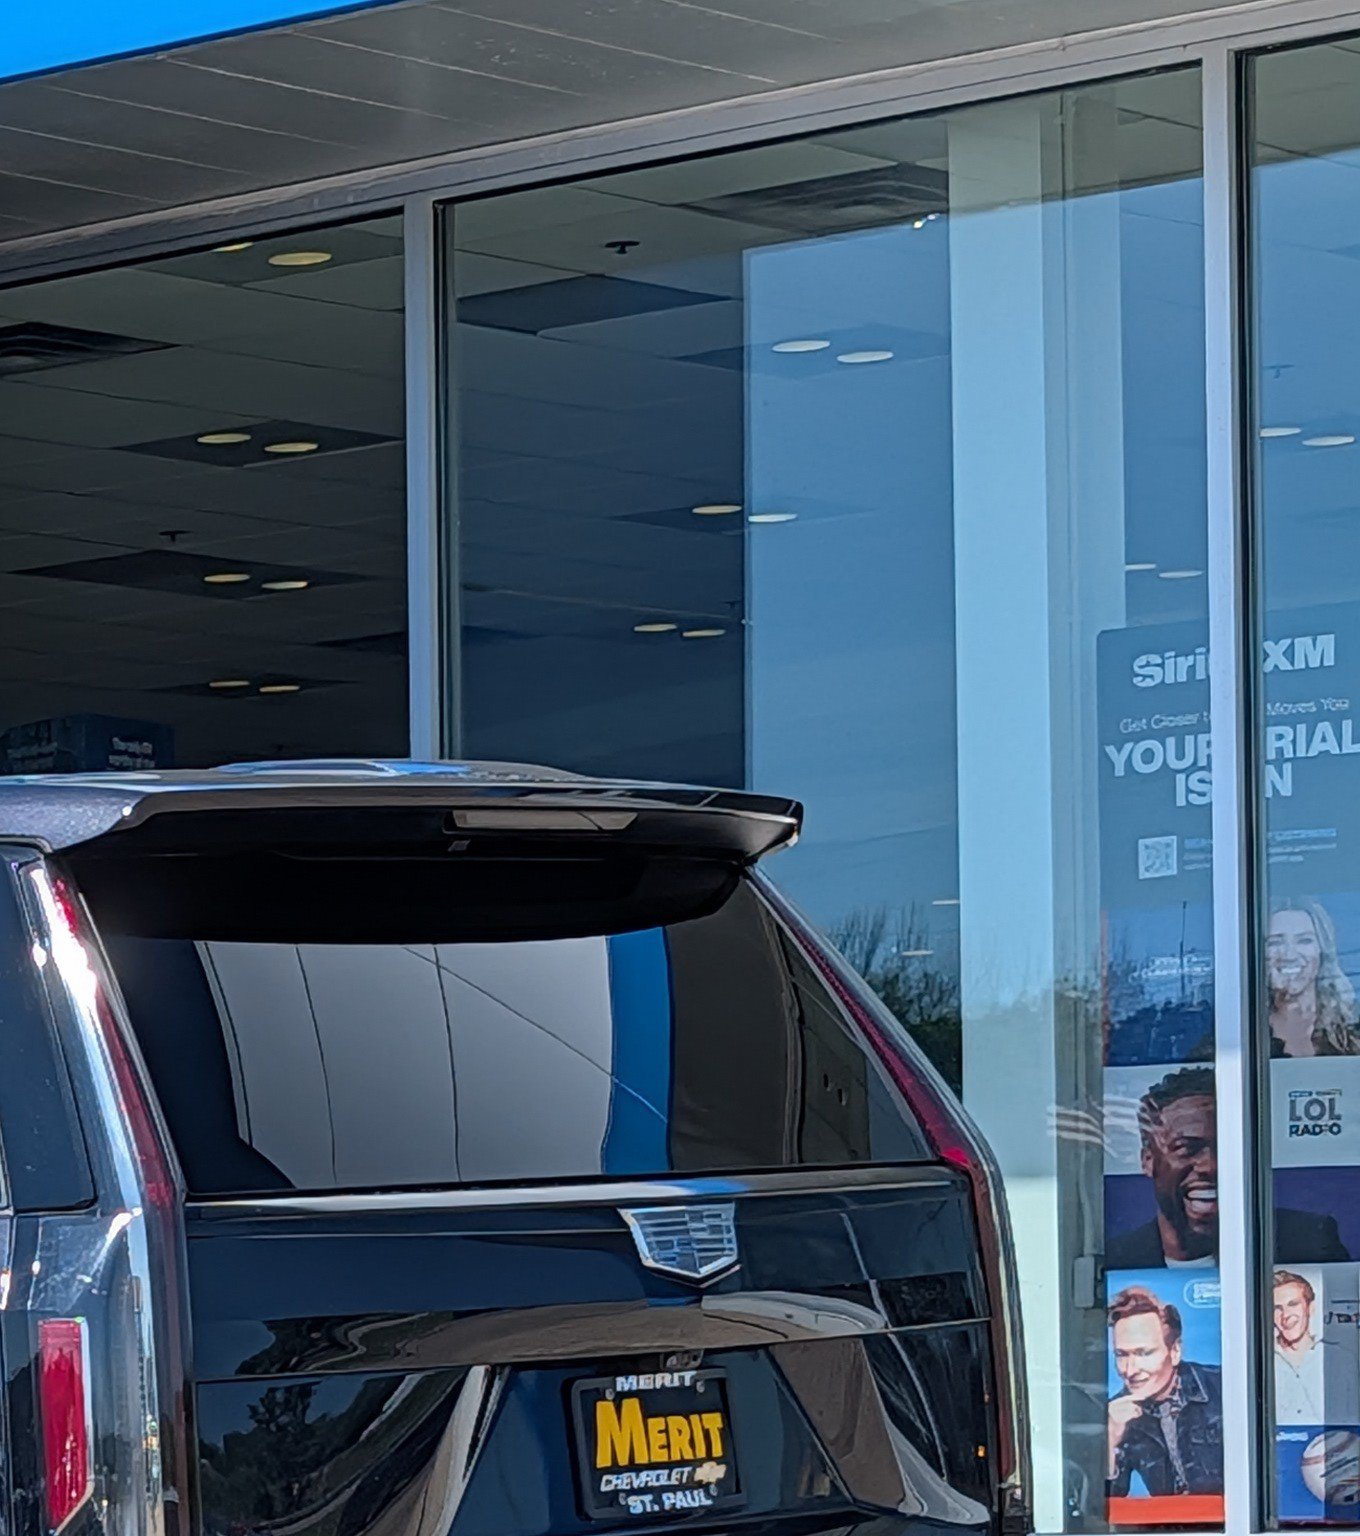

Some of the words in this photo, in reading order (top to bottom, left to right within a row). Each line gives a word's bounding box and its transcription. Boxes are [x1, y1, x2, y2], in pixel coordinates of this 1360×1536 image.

[1132, 633, 1335, 688] SiriXM
[1265, 719, 1360, 761] RIAL
[1176, 771, 1212, 807] IS
[1289, 1098, 1342, 1122] LOL
[615, 1370, 697, 1392] MERIT
[600, 1466, 693, 1492] CHEVROLET
[627, 1494, 659, 1514] ST.
[662, 1488, 713, 1510] PAUL
